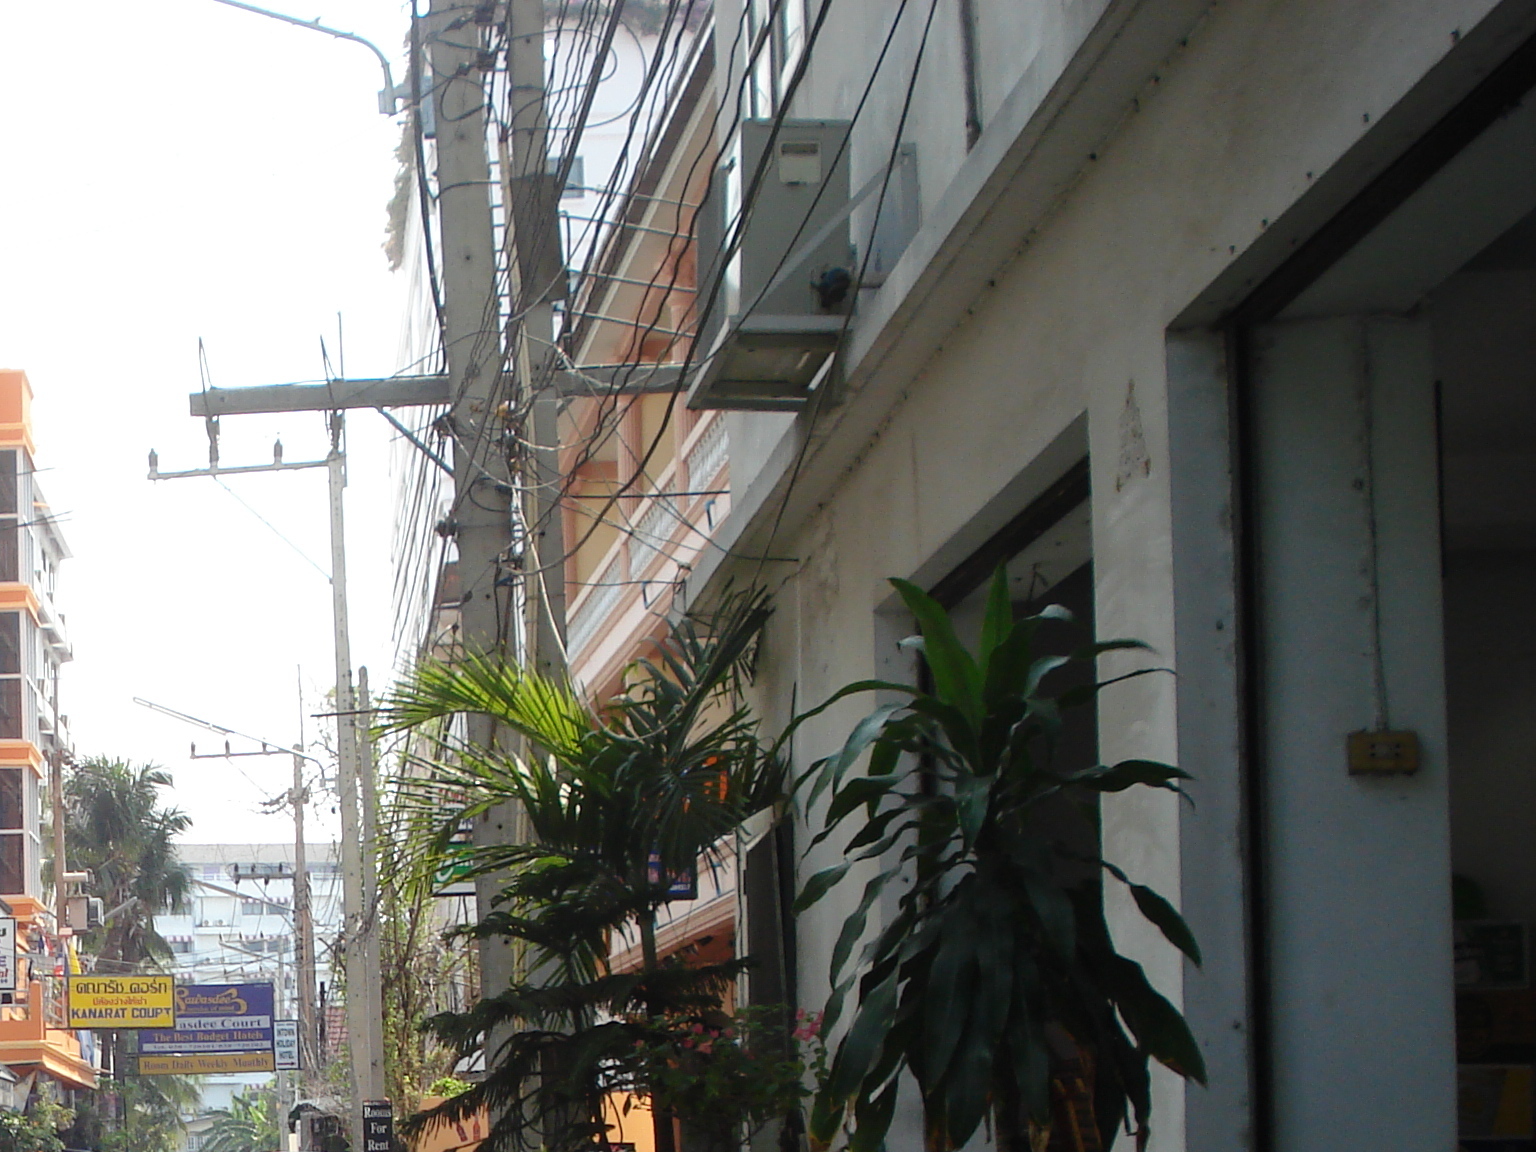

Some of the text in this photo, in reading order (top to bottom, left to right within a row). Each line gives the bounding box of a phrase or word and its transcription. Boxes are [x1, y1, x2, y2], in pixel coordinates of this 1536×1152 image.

[72, 1008, 127, 1019] KANARAT
[179, 1017, 262, 1029] asdee Court
[153, 1033, 171, 1042] The
[174, 1032, 193, 1041] Best
[197, 1031, 229, 1041] Budget
[198, 1059, 228, 1069] Weekly
[233, 1058, 268, 1068] Monthly
[364, 1106, 392, 1118] Rooms
[370, 1121, 387, 1134] For
[367, 1138, 389, 1151] Rent
